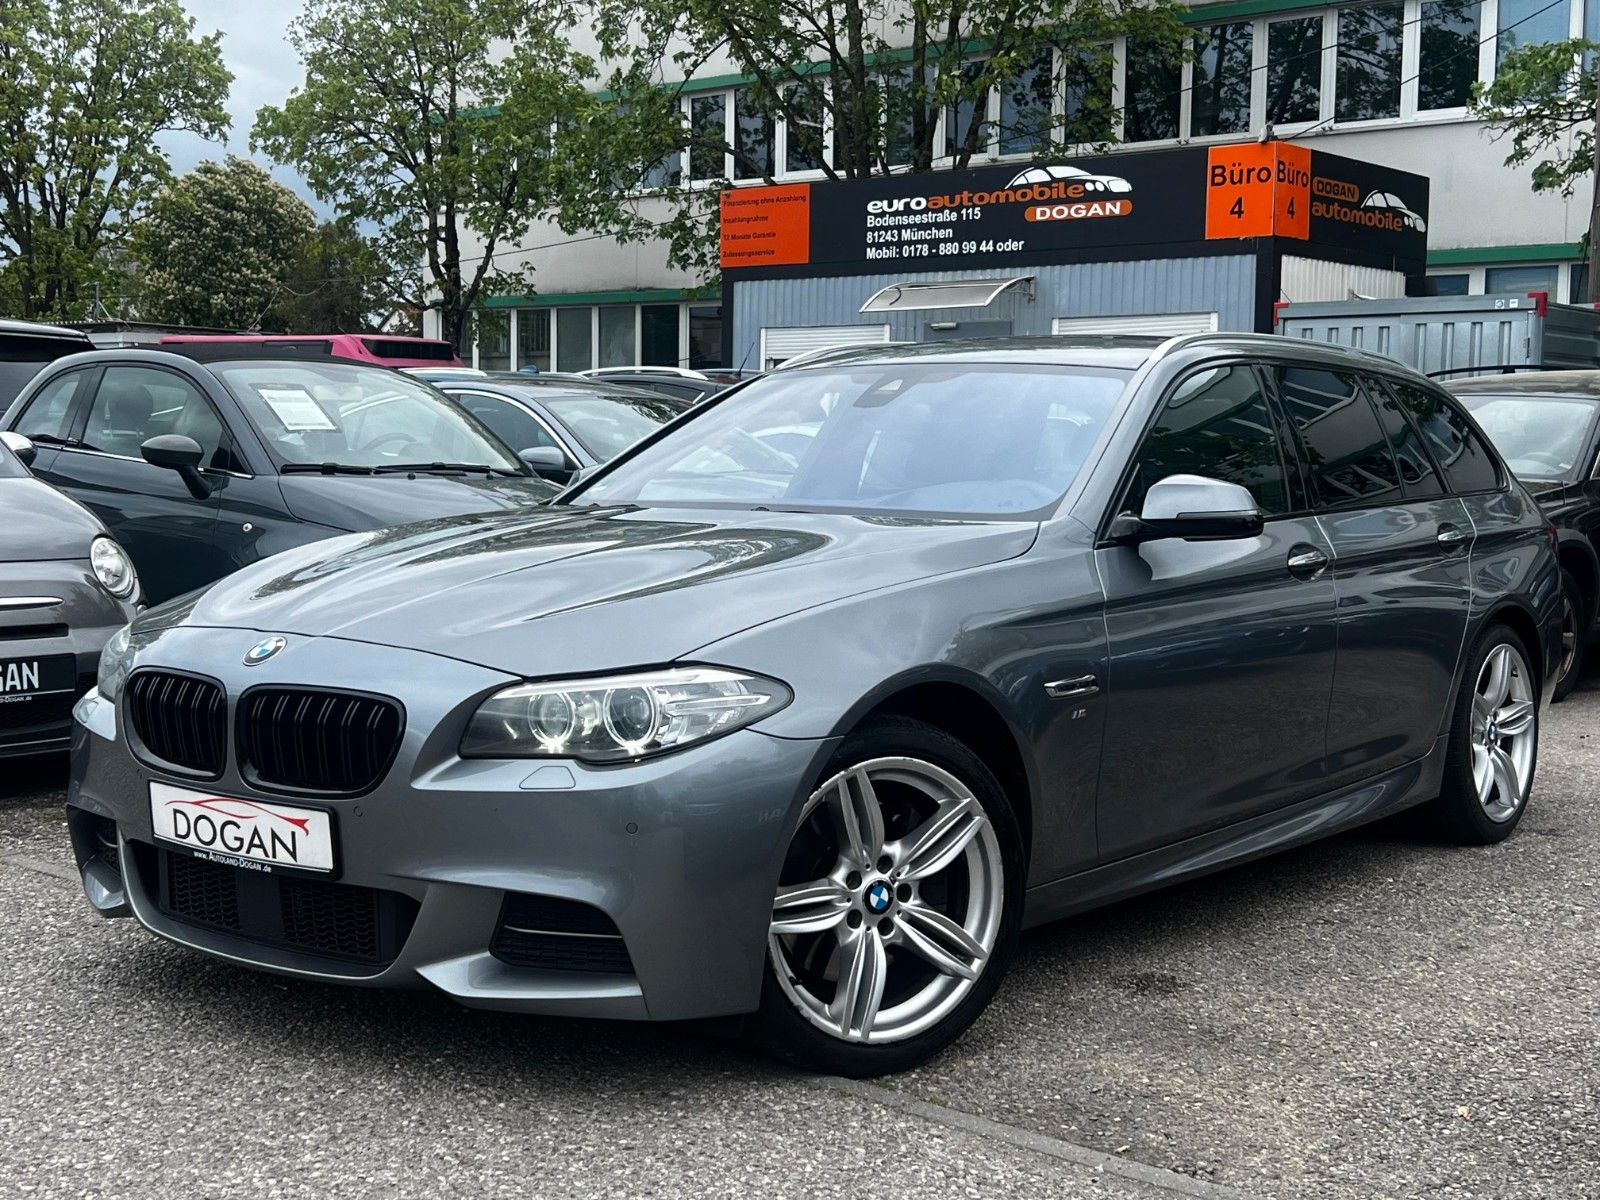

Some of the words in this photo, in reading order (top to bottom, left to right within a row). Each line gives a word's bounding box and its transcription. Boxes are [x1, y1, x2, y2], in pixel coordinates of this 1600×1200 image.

[1210, 162, 1271, 187] Büro
[1277, 160, 1309, 188] Büro
[775, 195, 806, 203] Anzahlung
[1317, 180, 1355, 200] DOGAN
[867, 209, 958, 227] Bodenseestraße
[961, 207, 981, 220] 115
[1035, 201, 1121, 221] DOGAN
[1230, 196, 1244, 219] 4
[1287, 196, 1296, 219] 4
[1312, 200, 1403, 232] automobile
[866, 231, 899, 244] 81243
[901, 227, 953, 242] München
[866, 245, 900, 260] Mobil:
[902, 244, 929, 258] 0178
[939, 242, 959, 255] 880
[962, 241, 977, 254] 99
[979, 240, 994, 253] 44
[996, 239, 1025, 252] oder
[172, 808, 298, 863] DOGAN
